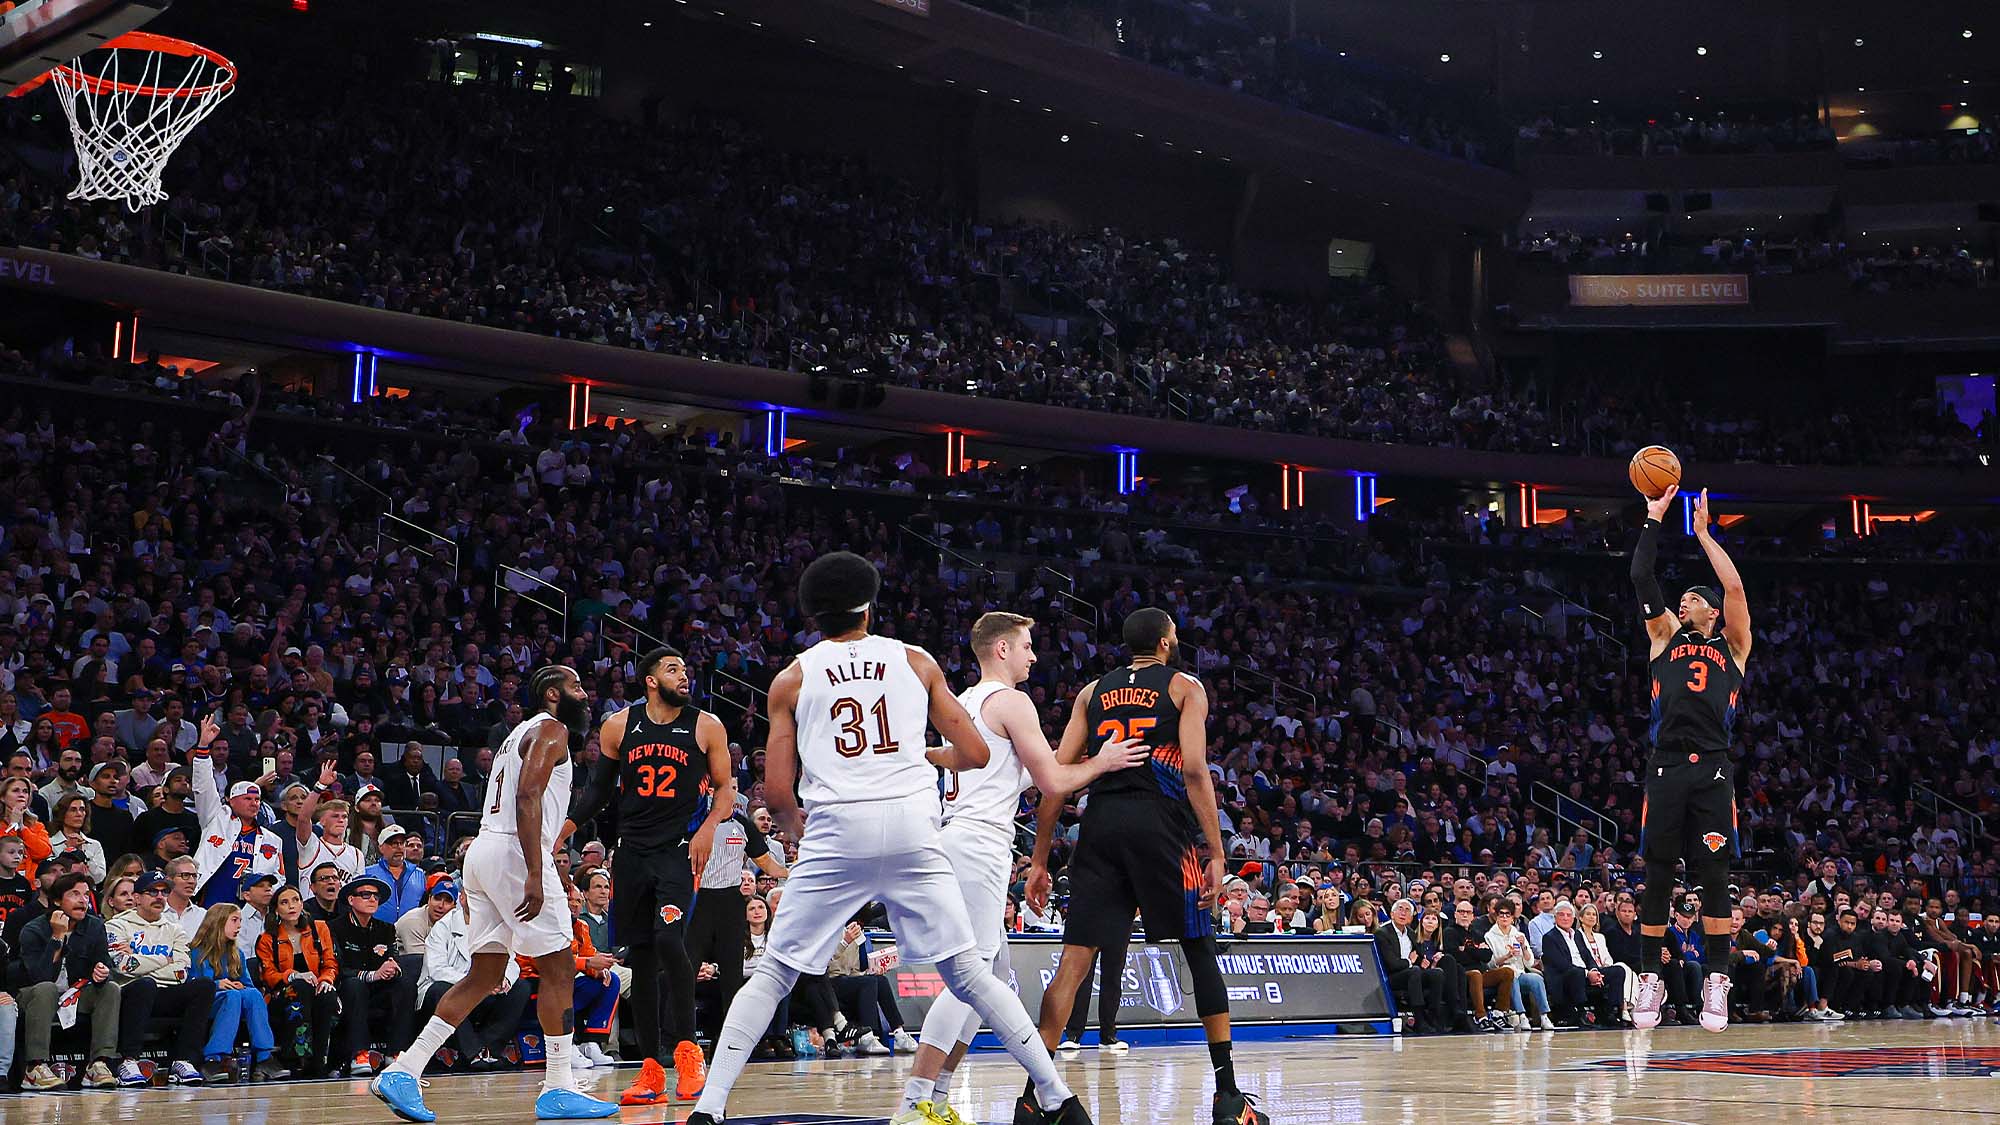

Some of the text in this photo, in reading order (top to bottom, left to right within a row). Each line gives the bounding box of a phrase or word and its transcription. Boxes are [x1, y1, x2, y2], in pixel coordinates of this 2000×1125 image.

[0, 257, 55, 285] EVEL
[1637, 283, 1685, 298] SUITE
[1692, 282, 1742, 297] LEVEL
[1670, 643, 1727, 673] NEW YORK
[825, 661, 886, 687] ALLEN
[1687, 660, 1709, 693] 3
[1100, 687, 1160, 711] BRIDGES
[830, 693, 899, 759] 31
[628, 743, 689, 767] NEW YORK
[490, 766, 505, 815] 1
[637, 764, 677, 798] 32
[232, 857, 250, 879] 7
[1216, 954, 1364, 975] NTINUE THROUGH JUNE
[1119, 996, 1135, 1007] 026
